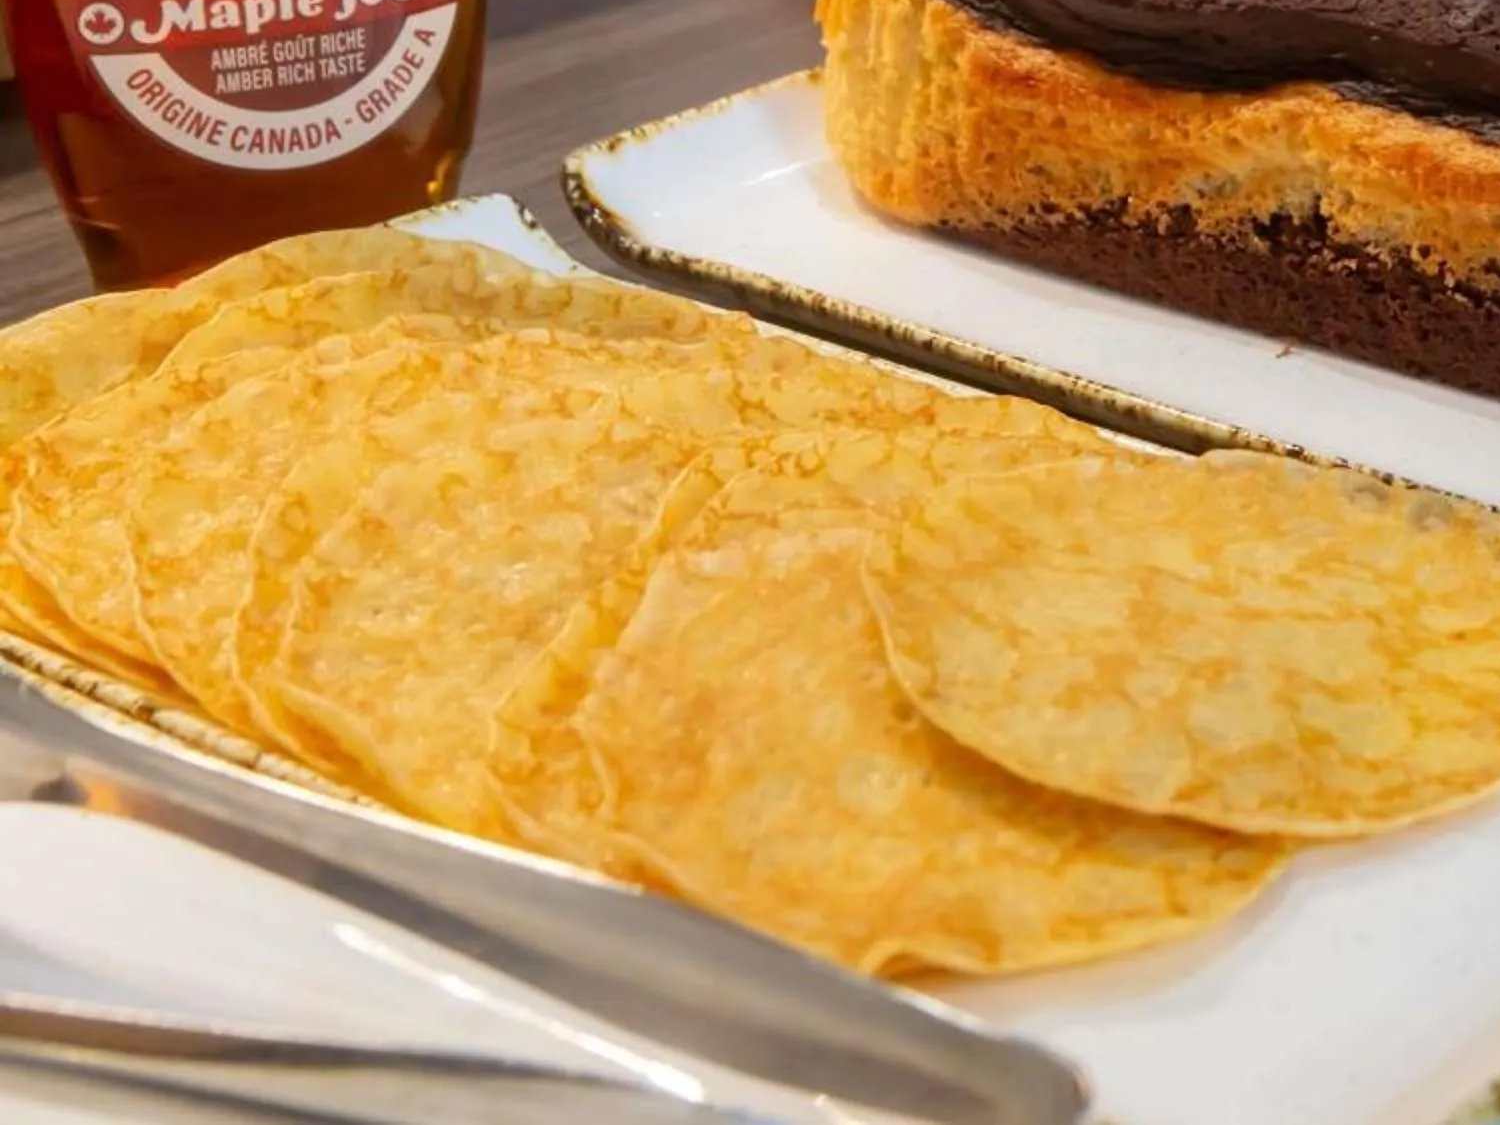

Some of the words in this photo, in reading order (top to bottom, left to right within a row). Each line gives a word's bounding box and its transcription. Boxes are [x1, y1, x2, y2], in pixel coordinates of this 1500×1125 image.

[210, 41, 269, 71] AMBRÉ
[273, 32, 315, 63] GOÛT
[320, 27, 366, 54] RICHE
[126, 67, 227, 147] ORIGINE
[230, 116, 342, 154] CANADA
[355, 50, 424, 125] GRADE
[415, 27, 436, 48] A
[215, 66, 273, 95] AMBER
[277, 61, 315, 87] RICH
[318, 51, 366, 78] TASTE
